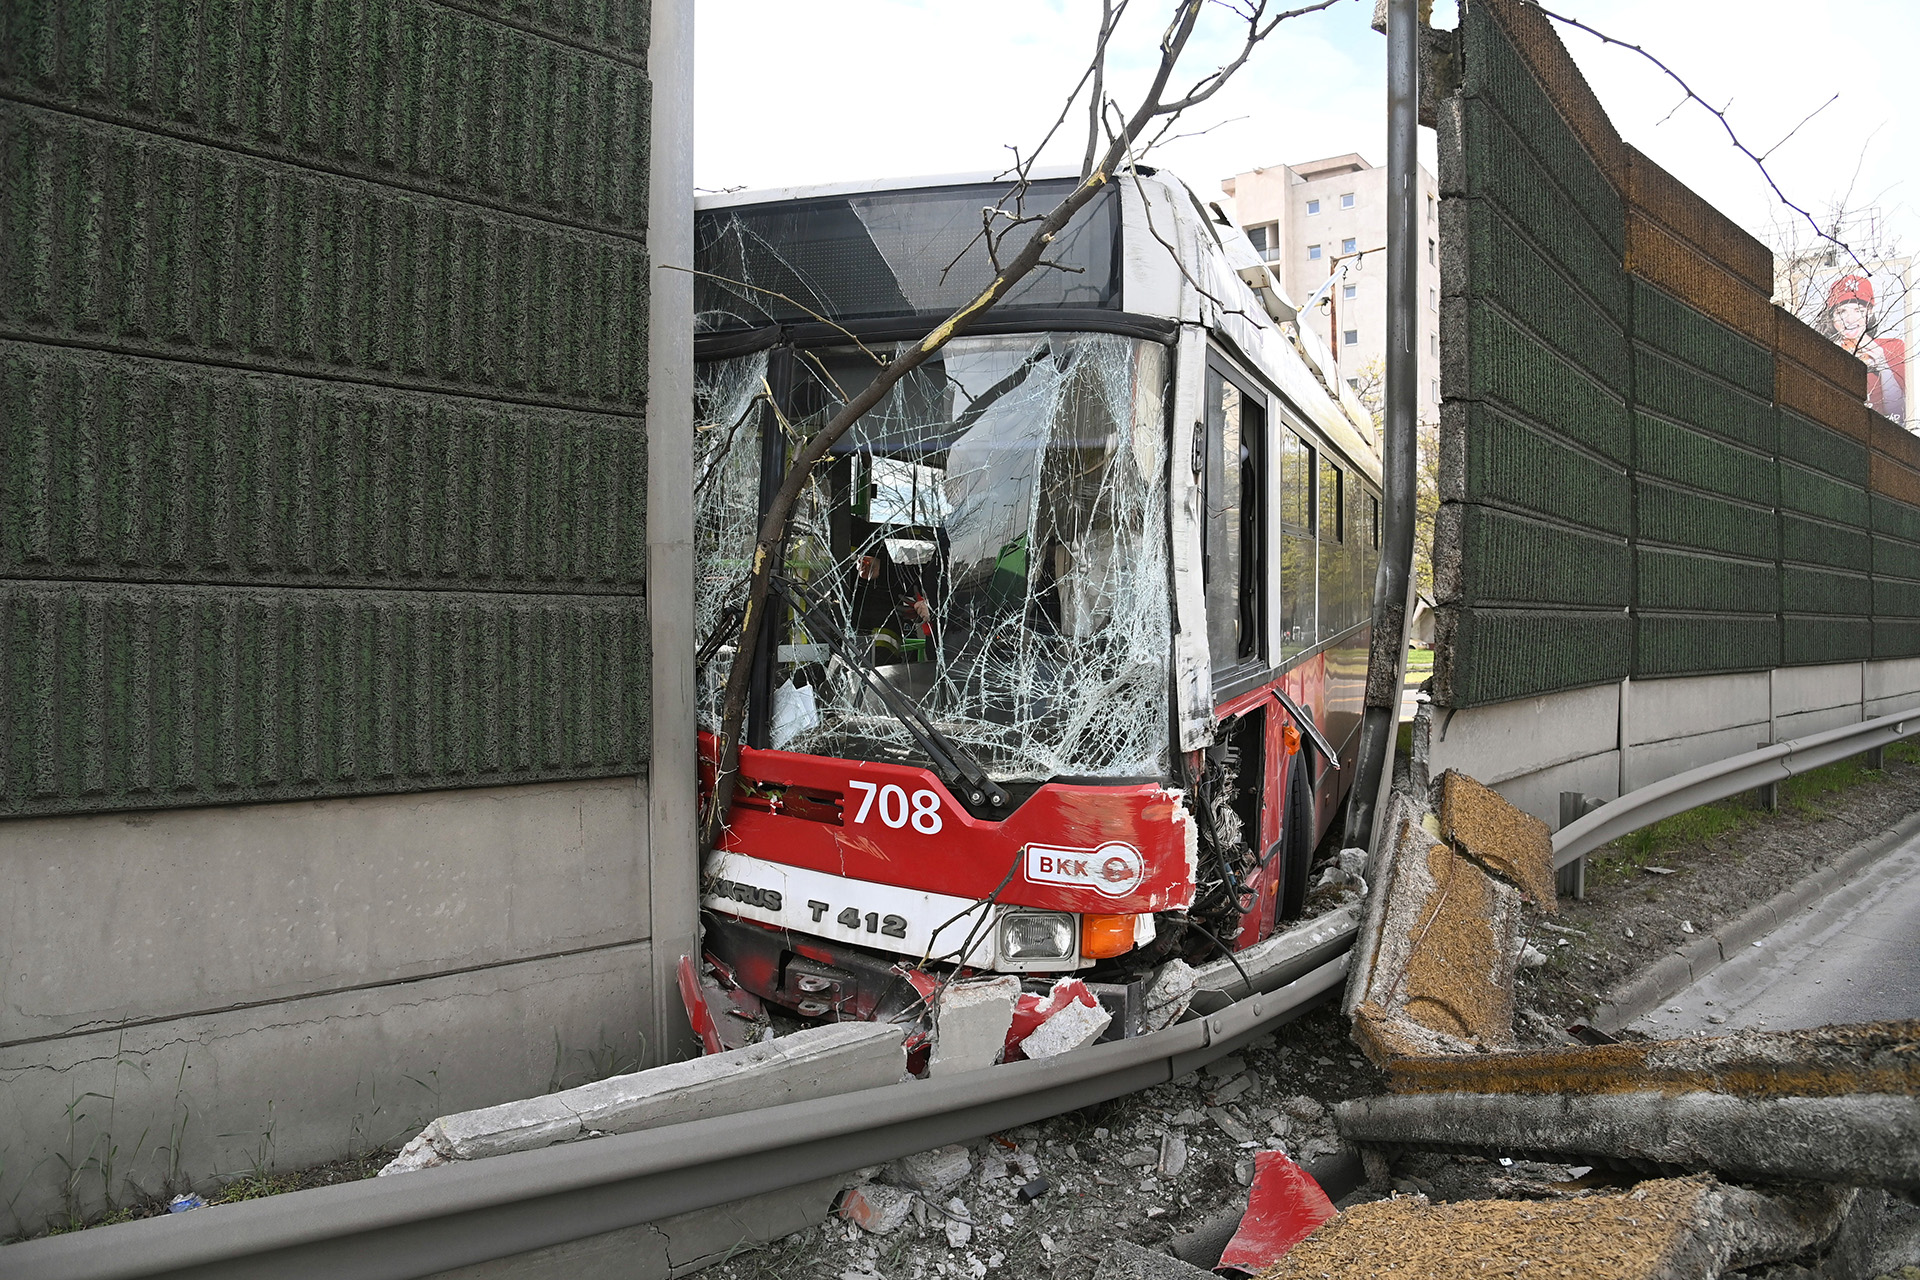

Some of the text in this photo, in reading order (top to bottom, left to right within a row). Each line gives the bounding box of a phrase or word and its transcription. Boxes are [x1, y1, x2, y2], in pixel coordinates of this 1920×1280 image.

[849, 779, 943, 835] 708
[1040, 856, 1089, 877] BKK
[807, 899, 829, 923] T
[837, 906, 908, 939] 412
